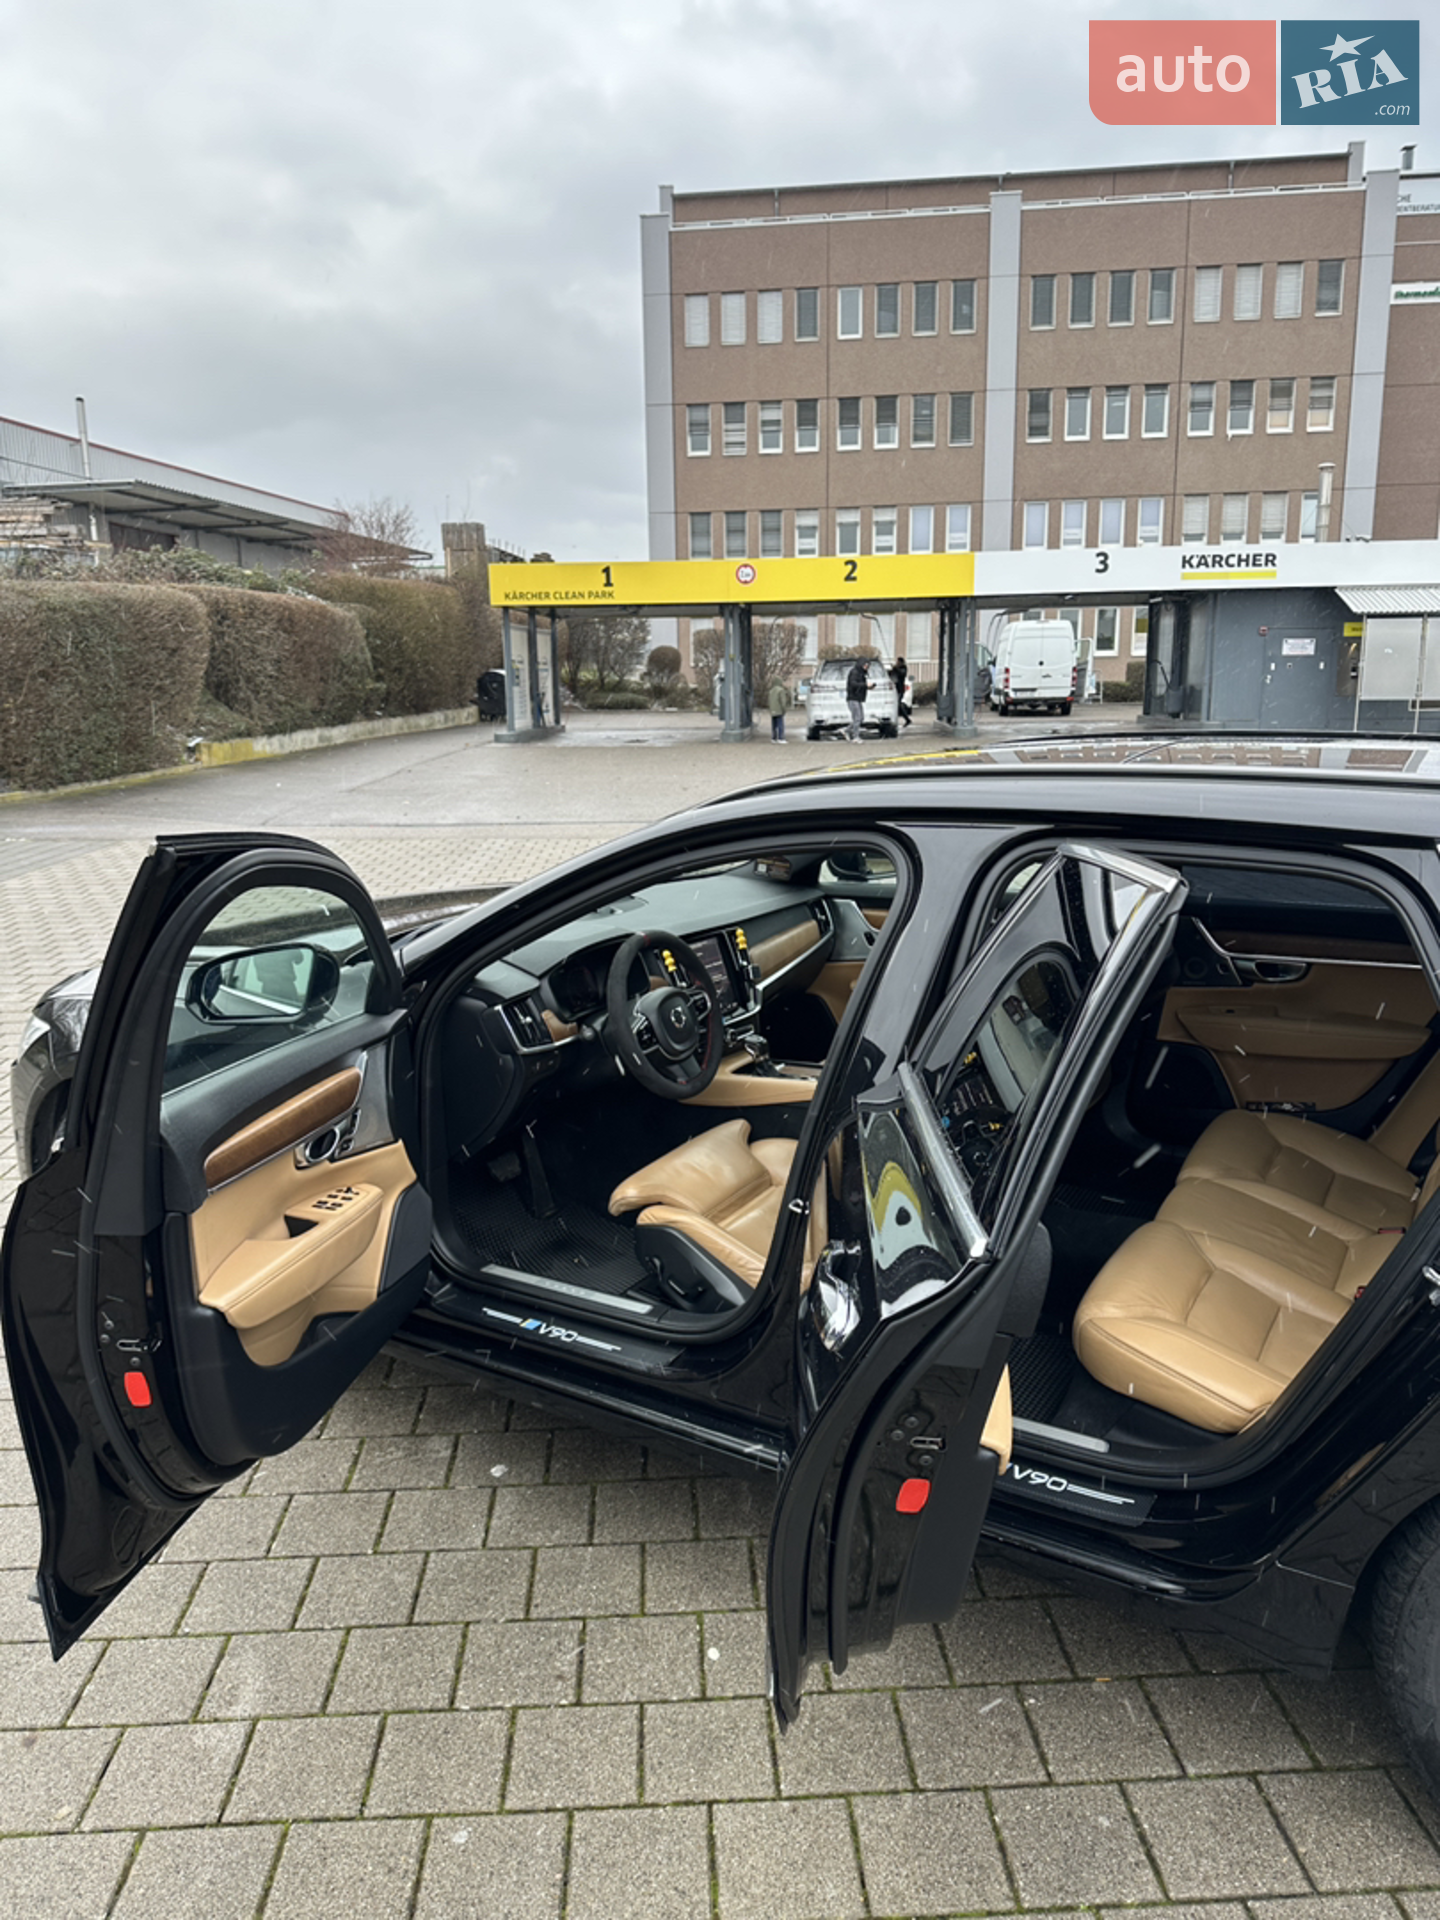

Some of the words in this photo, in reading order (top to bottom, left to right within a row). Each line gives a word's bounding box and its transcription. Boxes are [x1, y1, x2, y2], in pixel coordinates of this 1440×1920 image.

[843, 559, 858, 582] 2
[1095, 551, 1109, 574] 3
[1181, 552, 1277, 569] KÄRCHER
[601, 565, 614, 588] 1
[503, 589, 552, 602] KÄRCHER
[552, 589, 586, 601] CLEAN
[587, 589, 615, 600] PARK
[539, 1321, 578, 1342] V90
[1013, 1464, 1068, 1492] V90
